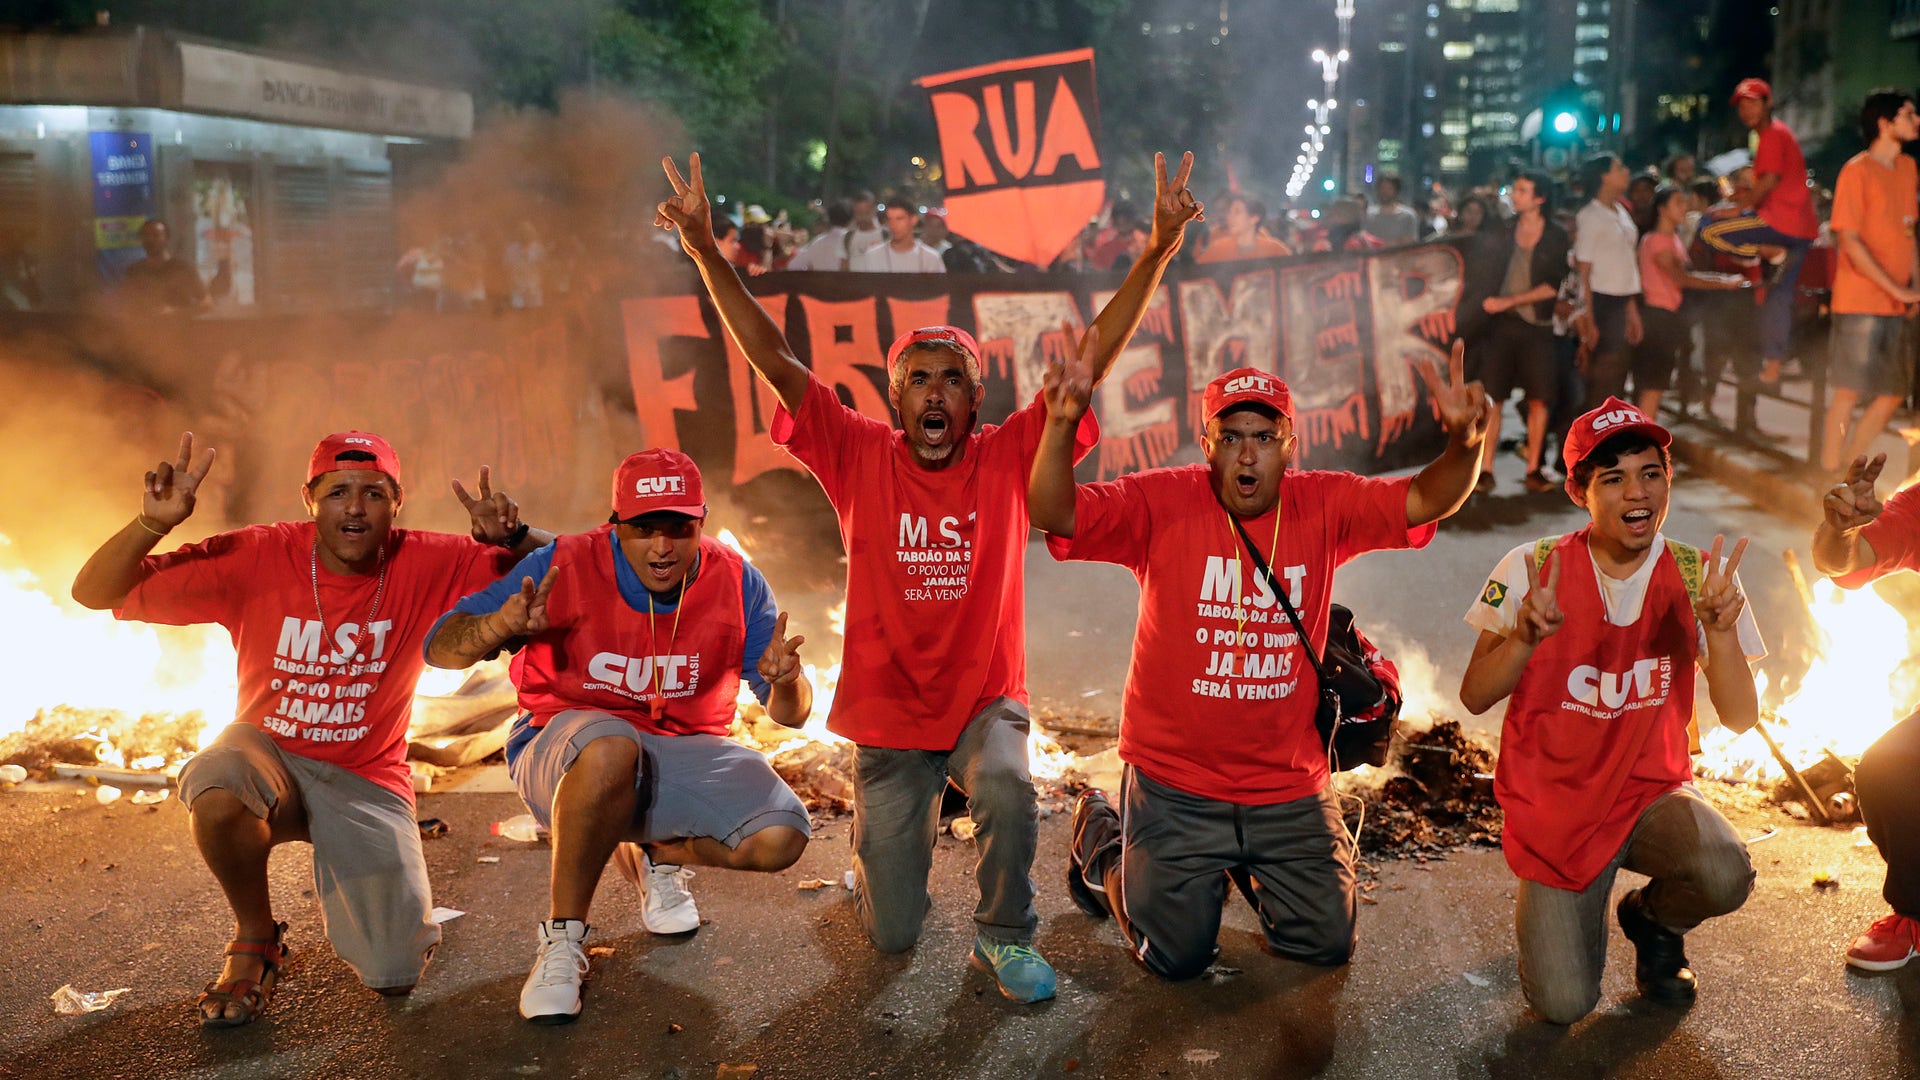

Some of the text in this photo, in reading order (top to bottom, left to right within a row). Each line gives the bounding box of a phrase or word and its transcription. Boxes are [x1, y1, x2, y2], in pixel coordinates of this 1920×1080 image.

[263, 80, 316, 108] BANCA
[930, 75, 1100, 190] RUA
[620, 293, 950, 486] FOR
[972, 243, 1466, 468] TEMER
[1224, 375, 1269, 393] CUT
[1592, 410, 1640, 430] CUT
[345, 437, 373, 447] CUT
[636, 476, 681, 494] CUT
[896, 549, 943, 562] TABOÃO
[945, 551, 961, 562] DA
[907, 565, 916, 575] O
[919, 564, 948, 576] POVO
[922, 577, 967, 587] JAMAIS
[1200, 555, 1307, 609] M.S.T
[904, 586, 933, 601] SERÁ
[1197, 603, 1247, 619] TABOÃO
[1250, 609, 1268, 623] DA
[276, 616, 392, 664] M.S.T
[1195, 628, 1208, 643] O
[1213, 629, 1258, 647] POVO
[273, 656, 325, 677] TABOÃO
[588, 651, 687, 693] CUT
[688, 652, 700, 690] BRASIL
[1660, 654, 1671, 697] BRASIL
[271, 678, 283, 690] O
[287, 679, 330, 698] POVO
[583, 682, 612, 692] CENTRAL
[613, 687, 633, 699] ÚNICA
[633, 694, 647, 702] DOS
[1191, 679, 1231, 699] SERÁ
[1567, 657, 1659, 709] CUT
[275, 696, 366, 724] JAMAIS
[1561, 701, 1591, 716] CENTRAL
[1591, 707, 1612, 720] ÚNICA
[263, 715, 298, 738] SERÁ
